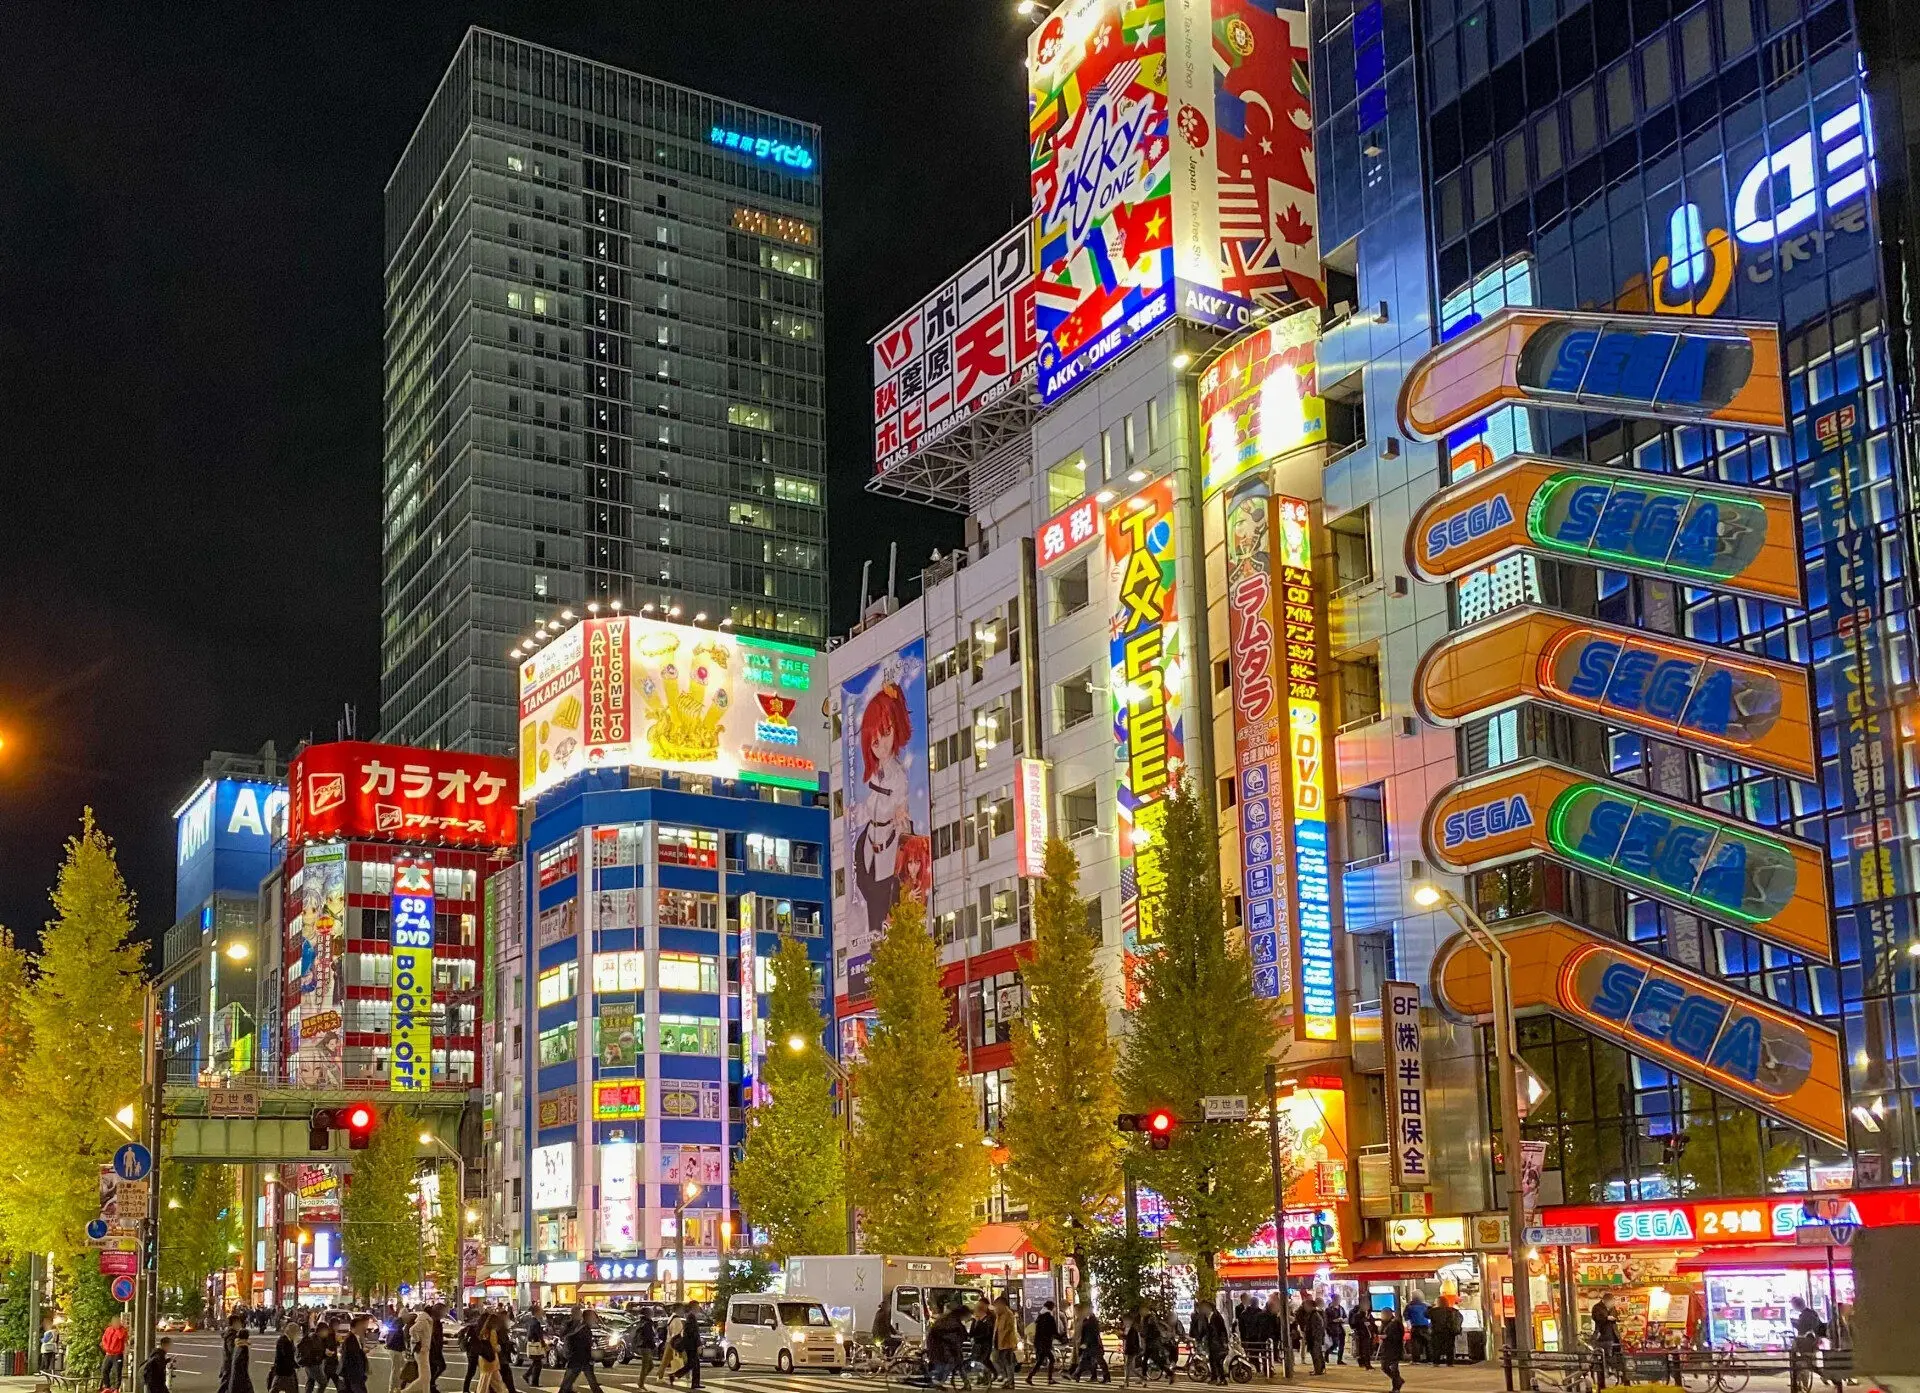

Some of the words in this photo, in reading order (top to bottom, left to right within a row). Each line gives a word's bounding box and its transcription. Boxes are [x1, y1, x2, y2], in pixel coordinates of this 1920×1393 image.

[1099, 161, 1140, 210] ONE
[1089, 329, 1122, 364] ONE
[875, 343, 951, 419] 秋葉原
[1546, 330, 1707, 408] SEGA
[1043, 503, 1093, 561] 免税
[1426, 493, 1517, 560] SEGA
[1556, 484, 1720, 568] SEGA
[1121, 503, 1163, 636] TAX
[1284, 567, 1311, 587] ゲーム
[1287, 587, 1309, 604] CD
[1235, 572, 1275, 722] ラムタラ
[1286, 624, 1315, 643] アニメ
[609, 624, 623, 708] WELCOME
[743, 652, 771, 668] TAX
[778, 658, 810, 674] FREE
[1290, 663, 1315, 680] ホビー
[523, 665, 581, 714] TAKARADA
[591, 632, 603, 740] AKIHABARA
[1568, 641, 1733, 736] SEGA
[611, 715, 622, 739] TO
[1126, 625, 1168, 796] FREE
[743, 747, 815, 772] TAKARADA
[1296, 733, 1321, 812] DVD
[361, 760, 507, 806] カラオケ
[1443, 794, 1534, 849] SEGA
[1577, 799, 1747, 910] SEGA
[401, 898, 427, 913] CD
[396, 930, 431, 946] DVD
[1393, 996, 1418, 1016] 8F
[1590, 962, 1763, 1082] SEGA
[213, 1093, 254, 1104] 万世橋
[1209, 1099, 1245, 1109] 万世橋
[662, 1155, 671, 1166] 2F
[669, 1168, 679, 1179] 3F
[1546, 1227, 1582, 1237] 中央通り
[1616, 1209, 1694, 1242] SEGA
[1703, 1209, 1762, 1234] 2号館
[1835, 1226, 1848, 1240] 17
